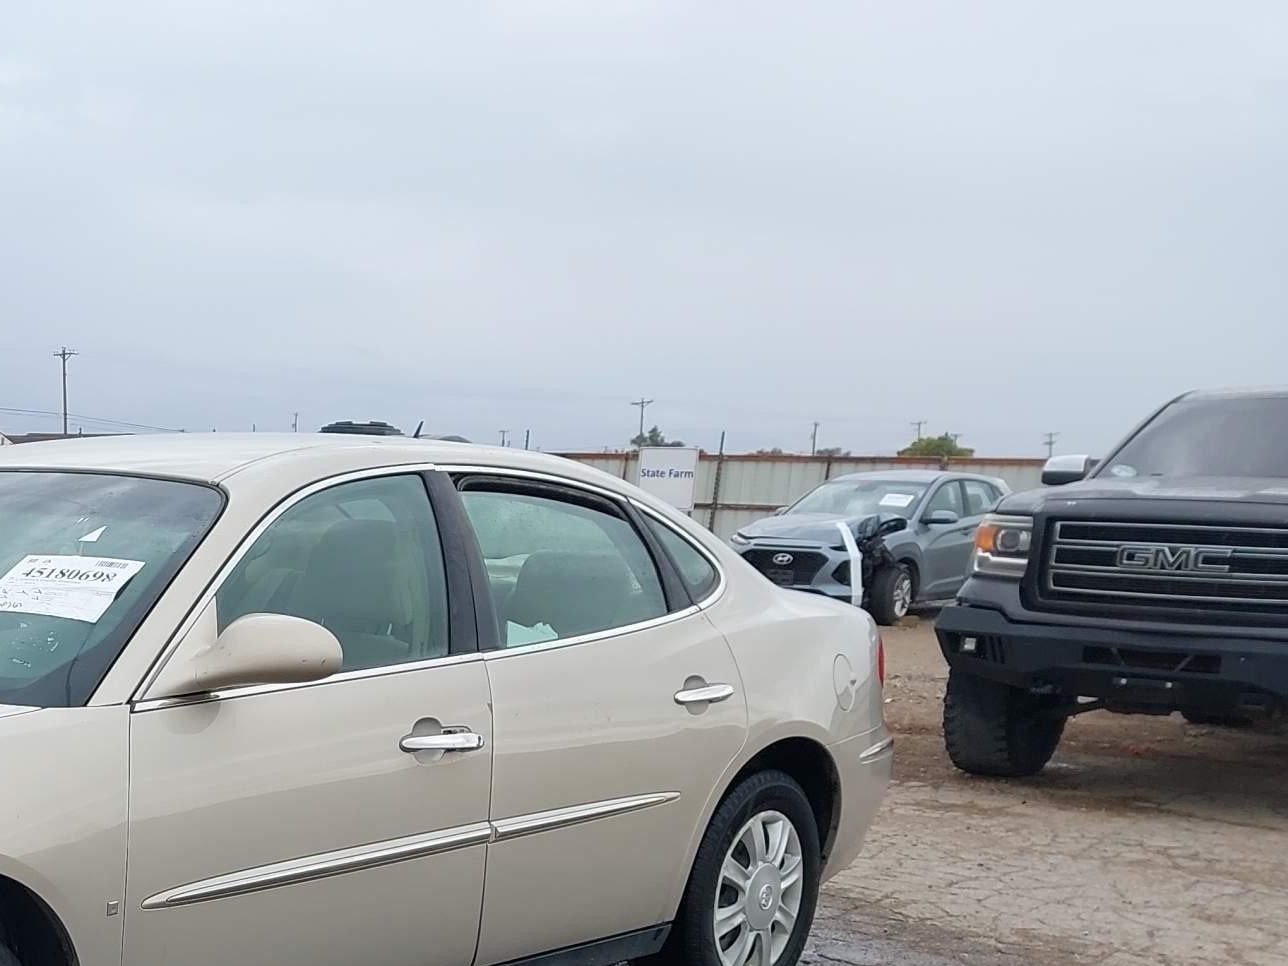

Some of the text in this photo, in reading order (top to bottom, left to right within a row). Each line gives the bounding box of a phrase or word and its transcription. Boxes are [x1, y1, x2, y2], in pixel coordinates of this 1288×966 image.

[640, 468, 694, 479] State Farm
[1115, 544, 1234, 573] GMC
[22, 567, 117, 583] 45180698
